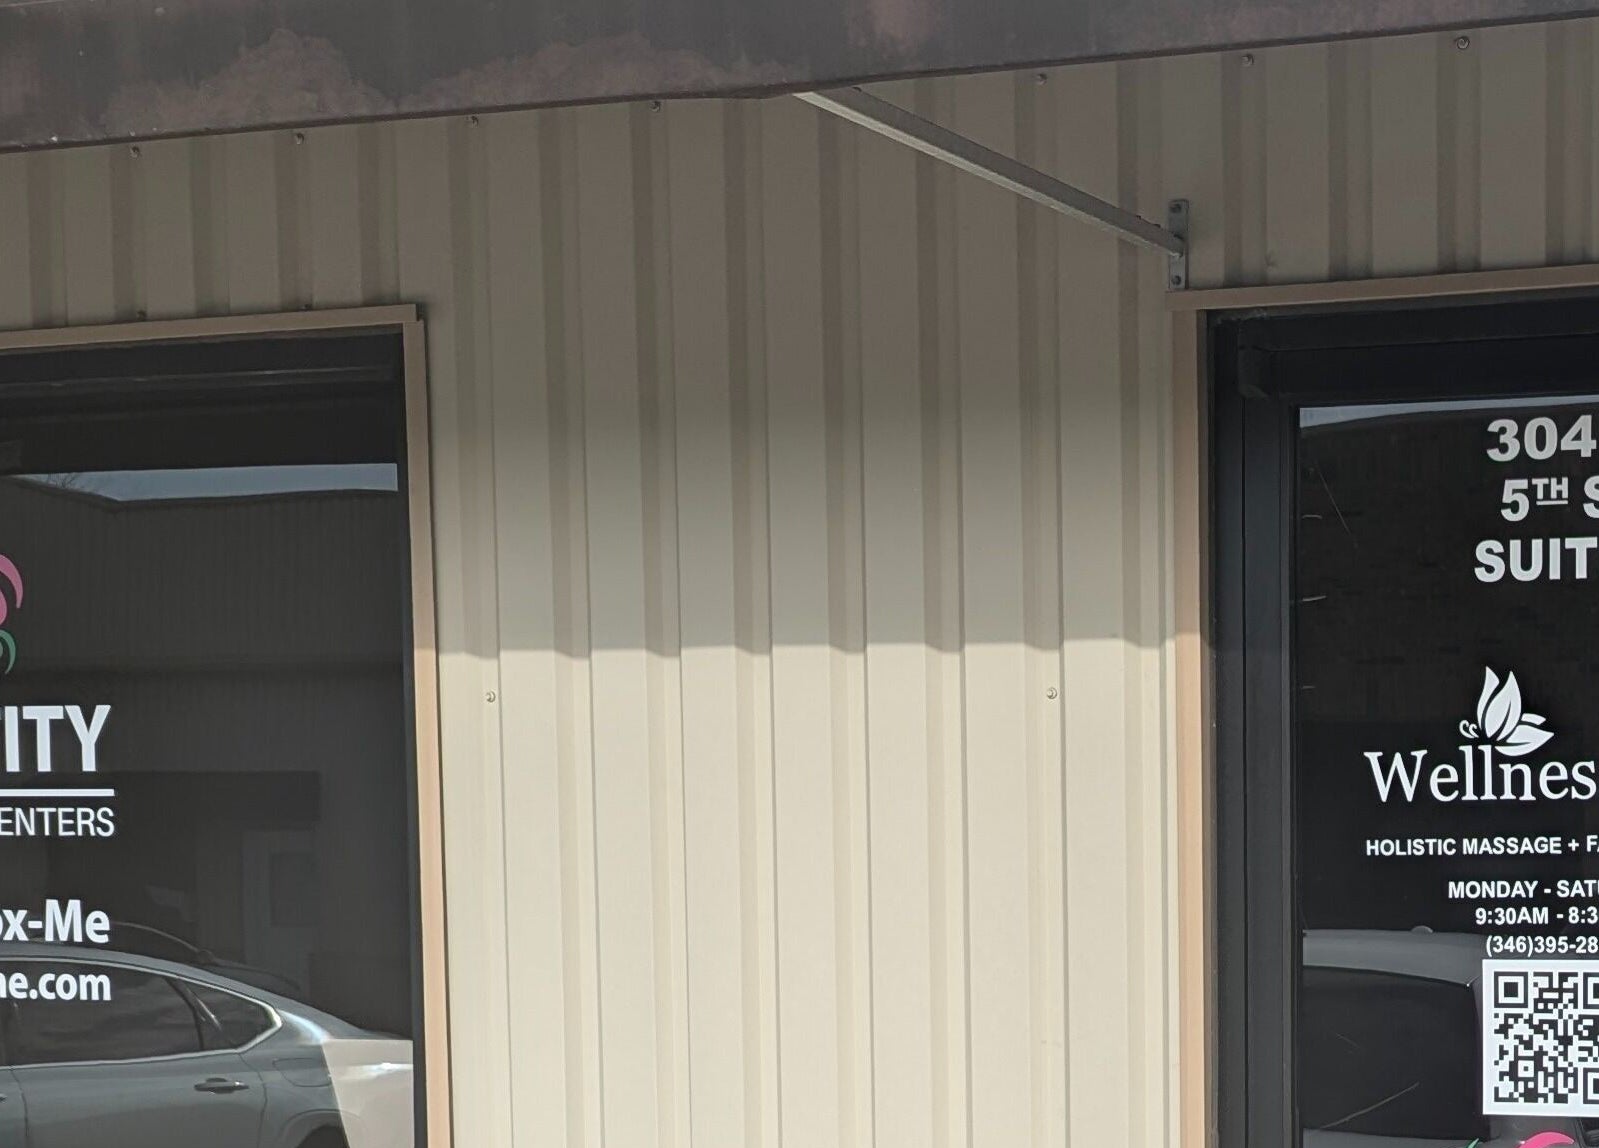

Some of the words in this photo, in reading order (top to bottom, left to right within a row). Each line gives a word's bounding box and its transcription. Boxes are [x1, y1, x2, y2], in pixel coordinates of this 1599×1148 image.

[1500, 476, 1569, 522] 5TH
[0, 704, 112, 773] ITY
[1366, 837, 1457, 857] HOLISTIC
[1462, 836, 1562, 856] MASSAGE
[1448, 880, 1539, 900] MONDAY
[0, 898, 111, 944] x-Me
[1475, 906, 1549, 926] 9:30AM
